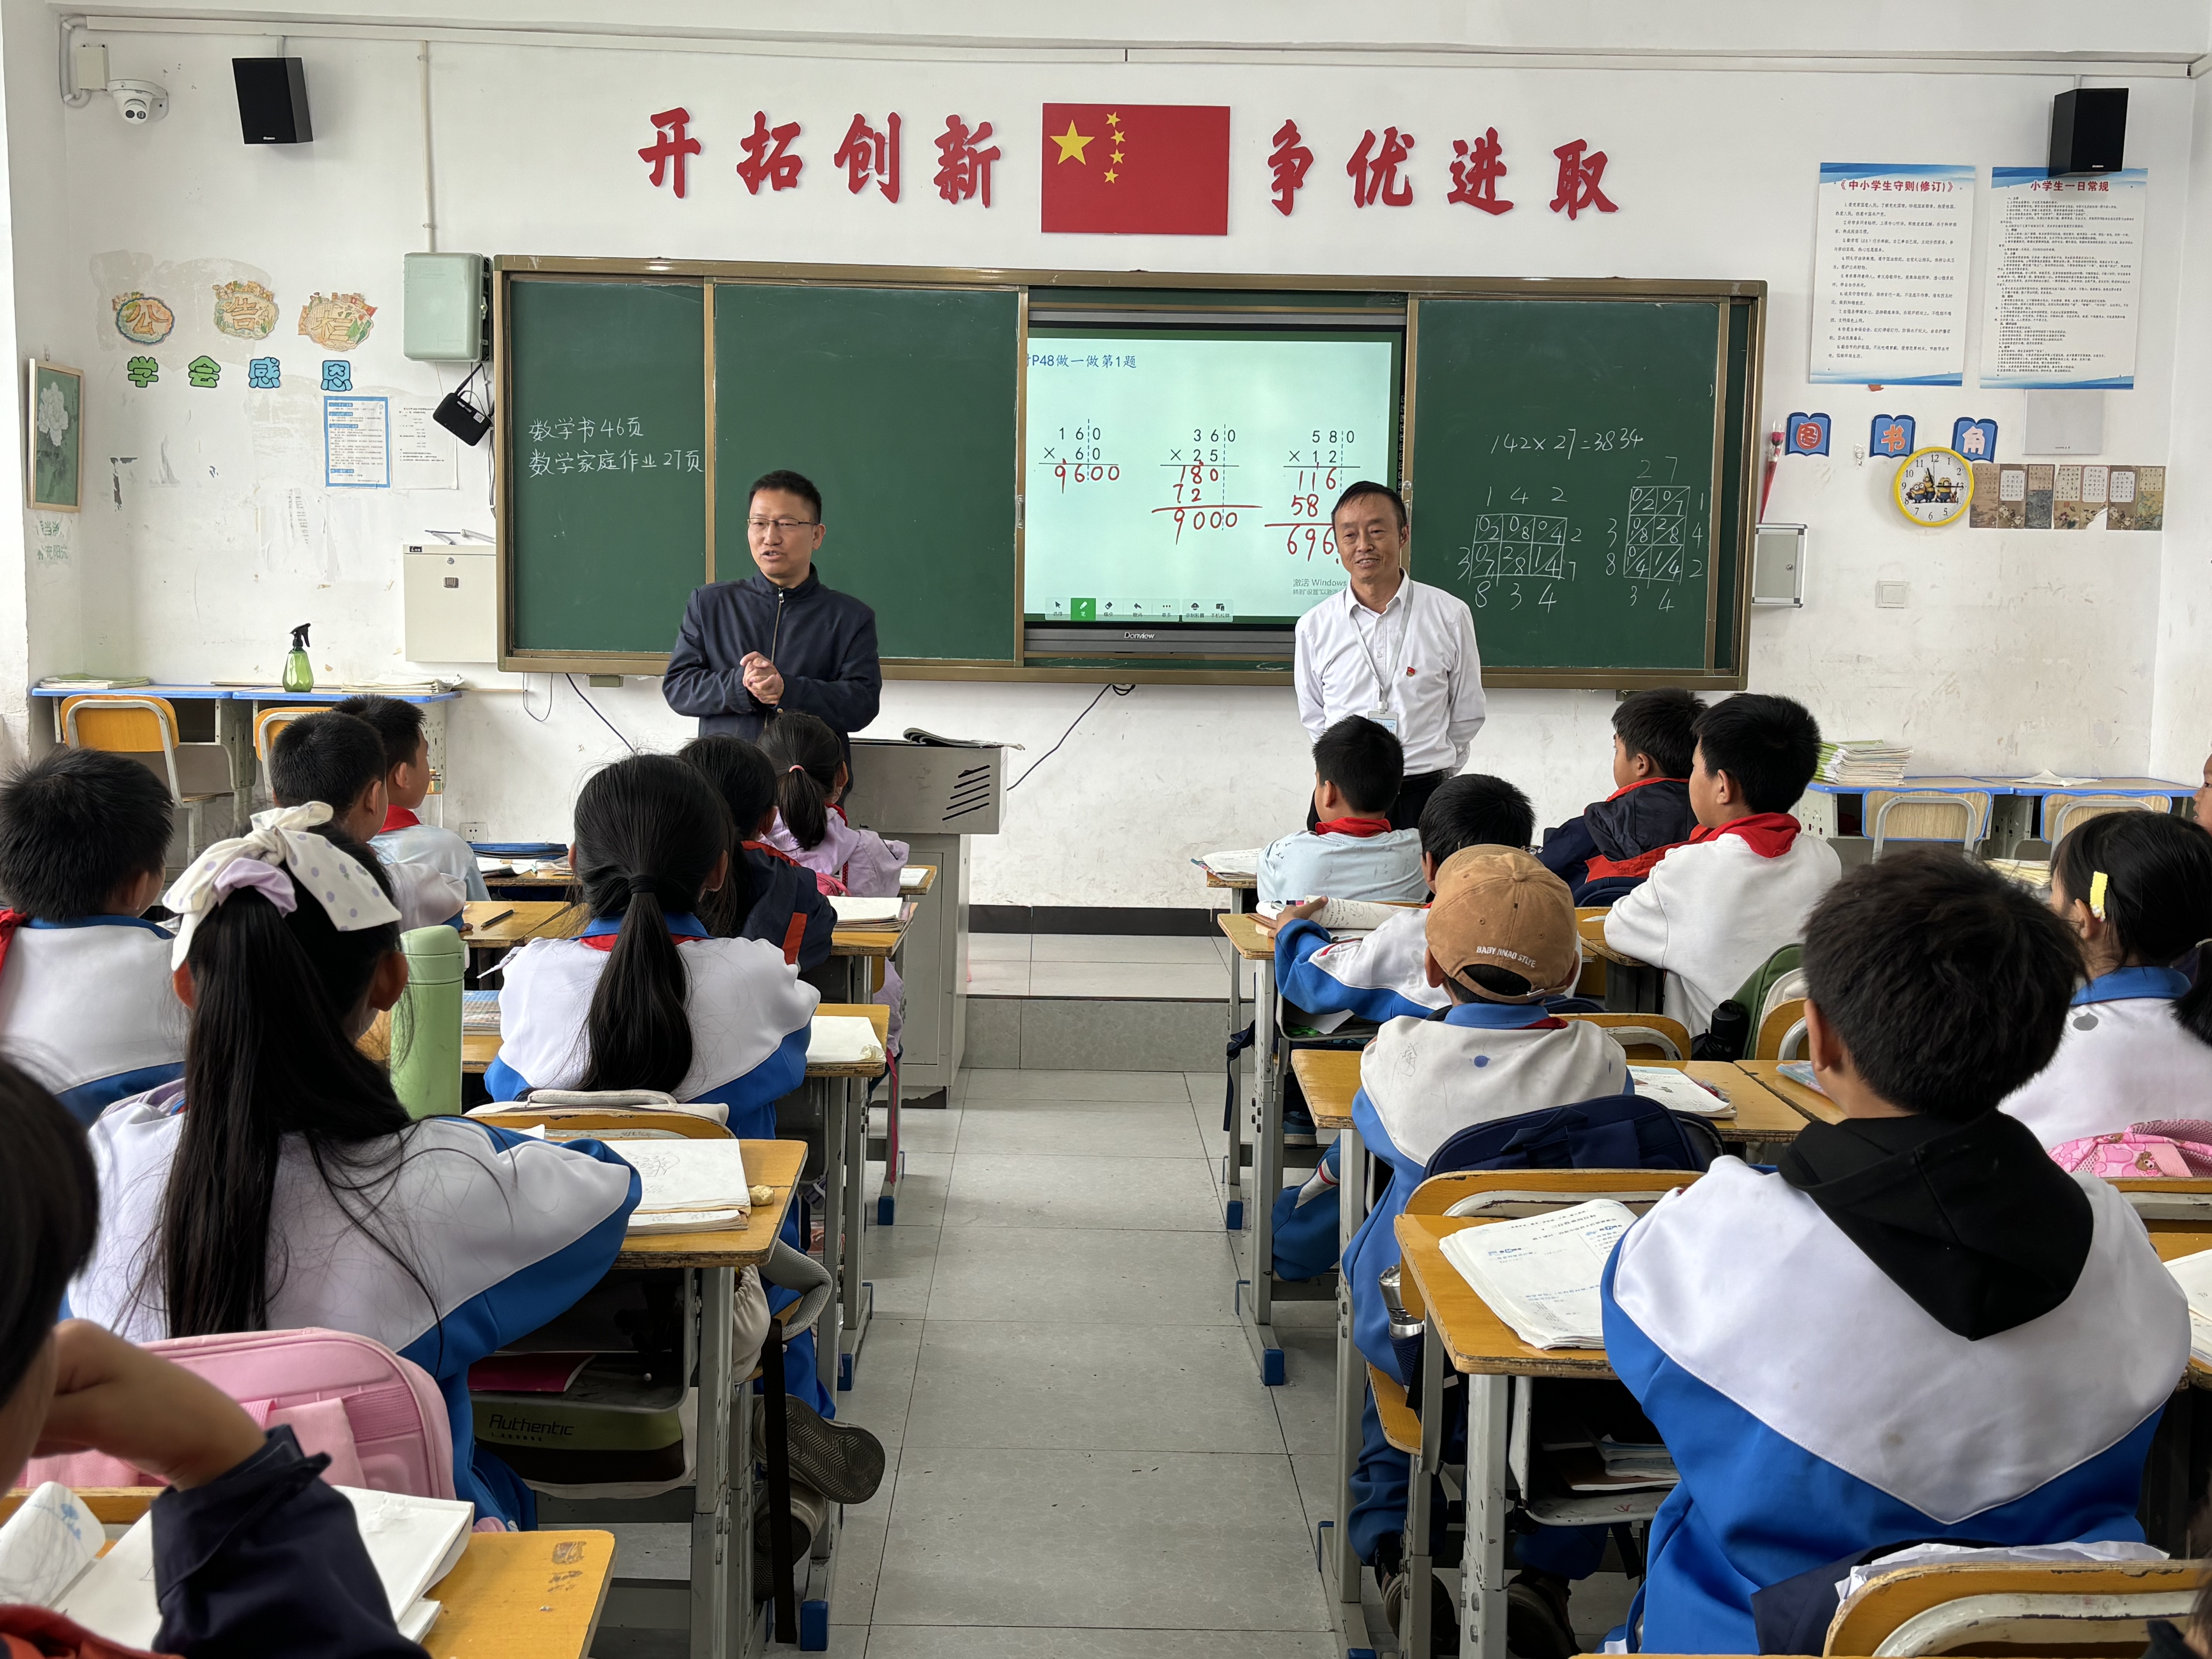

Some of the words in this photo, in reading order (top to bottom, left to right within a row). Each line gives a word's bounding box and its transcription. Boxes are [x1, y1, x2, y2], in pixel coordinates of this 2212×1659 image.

[638, 107, 1001, 208] 开拓创新
[1267, 119, 1618, 220] 争优进取
[1839, 179, 1954, 192] 《中小学生守则(修订)》
[2030, 180, 2109, 192] 小学生一日常规
[127, 356, 353, 392] 学会感恩
[529, 417, 644, 443] 数学书46页
[529, 448, 704, 478] 数学家庭作业27页
[1916, 459, 1923, 467] 11
[1931, 454, 1939, 462] 12
[1948, 457, 1950, 465] 1
[1906, 469, 1914, 477] 10
[1956, 467, 1961, 476] 2
[1929, 512, 1933, 521] 6
[1943, 508, 1948, 516] 5
[1476, 946, 1497, 955] BABY
[489, 1413, 575, 1436] Authentic
